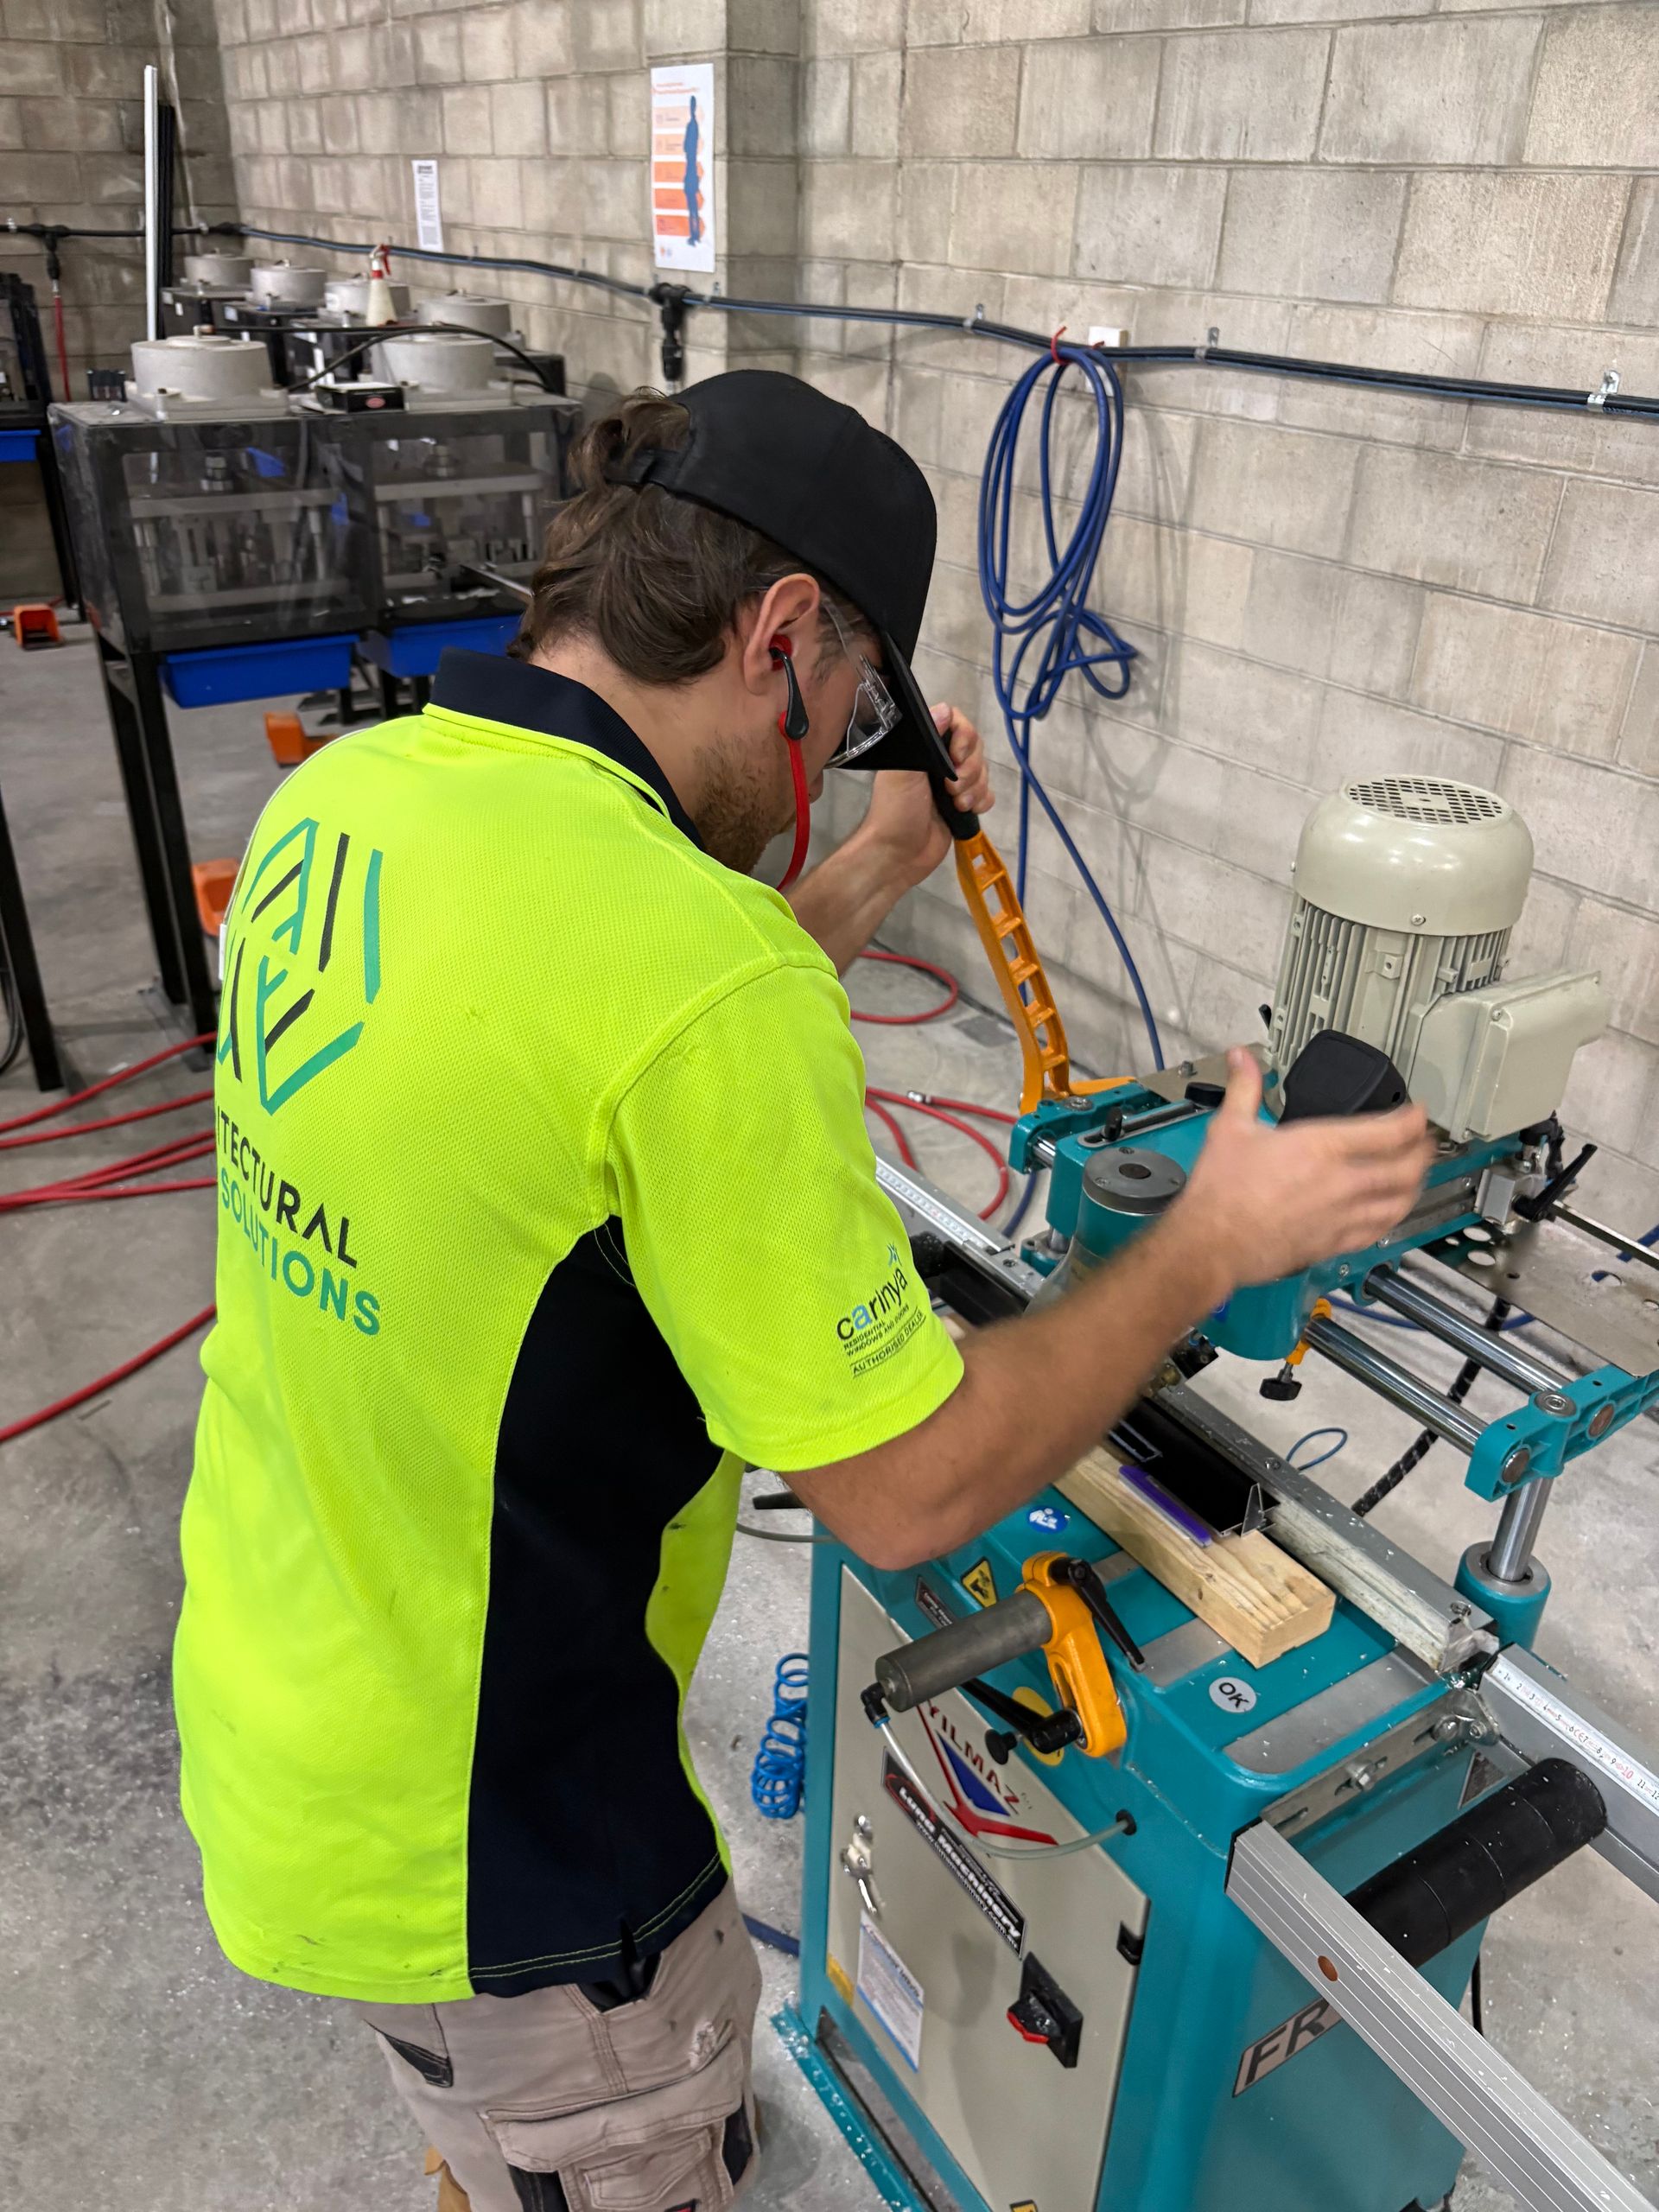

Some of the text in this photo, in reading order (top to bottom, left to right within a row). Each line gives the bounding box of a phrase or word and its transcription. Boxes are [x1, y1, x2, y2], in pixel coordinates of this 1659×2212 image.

[221, 1167, 380, 1336] SOLUTIONS
[836, 1268, 908, 1340] carinya
[843, 1320, 886, 1351] RESIDENTIAL
[847, 1332, 883, 1357] WINDOWS
[853, 1333, 905, 1374] AUTHORISED
[1218, 1682, 1249, 1708] OK
[927, 1698, 1020, 1815] YILMAZ
[1621, 1766, 1634, 1779] 10
[1637, 1779, 1645, 1789] 11
[899, 1786, 936, 1834] Luna
[938, 1834, 1021, 1938] Machinery
[1245, 1998, 1330, 2086] FR
